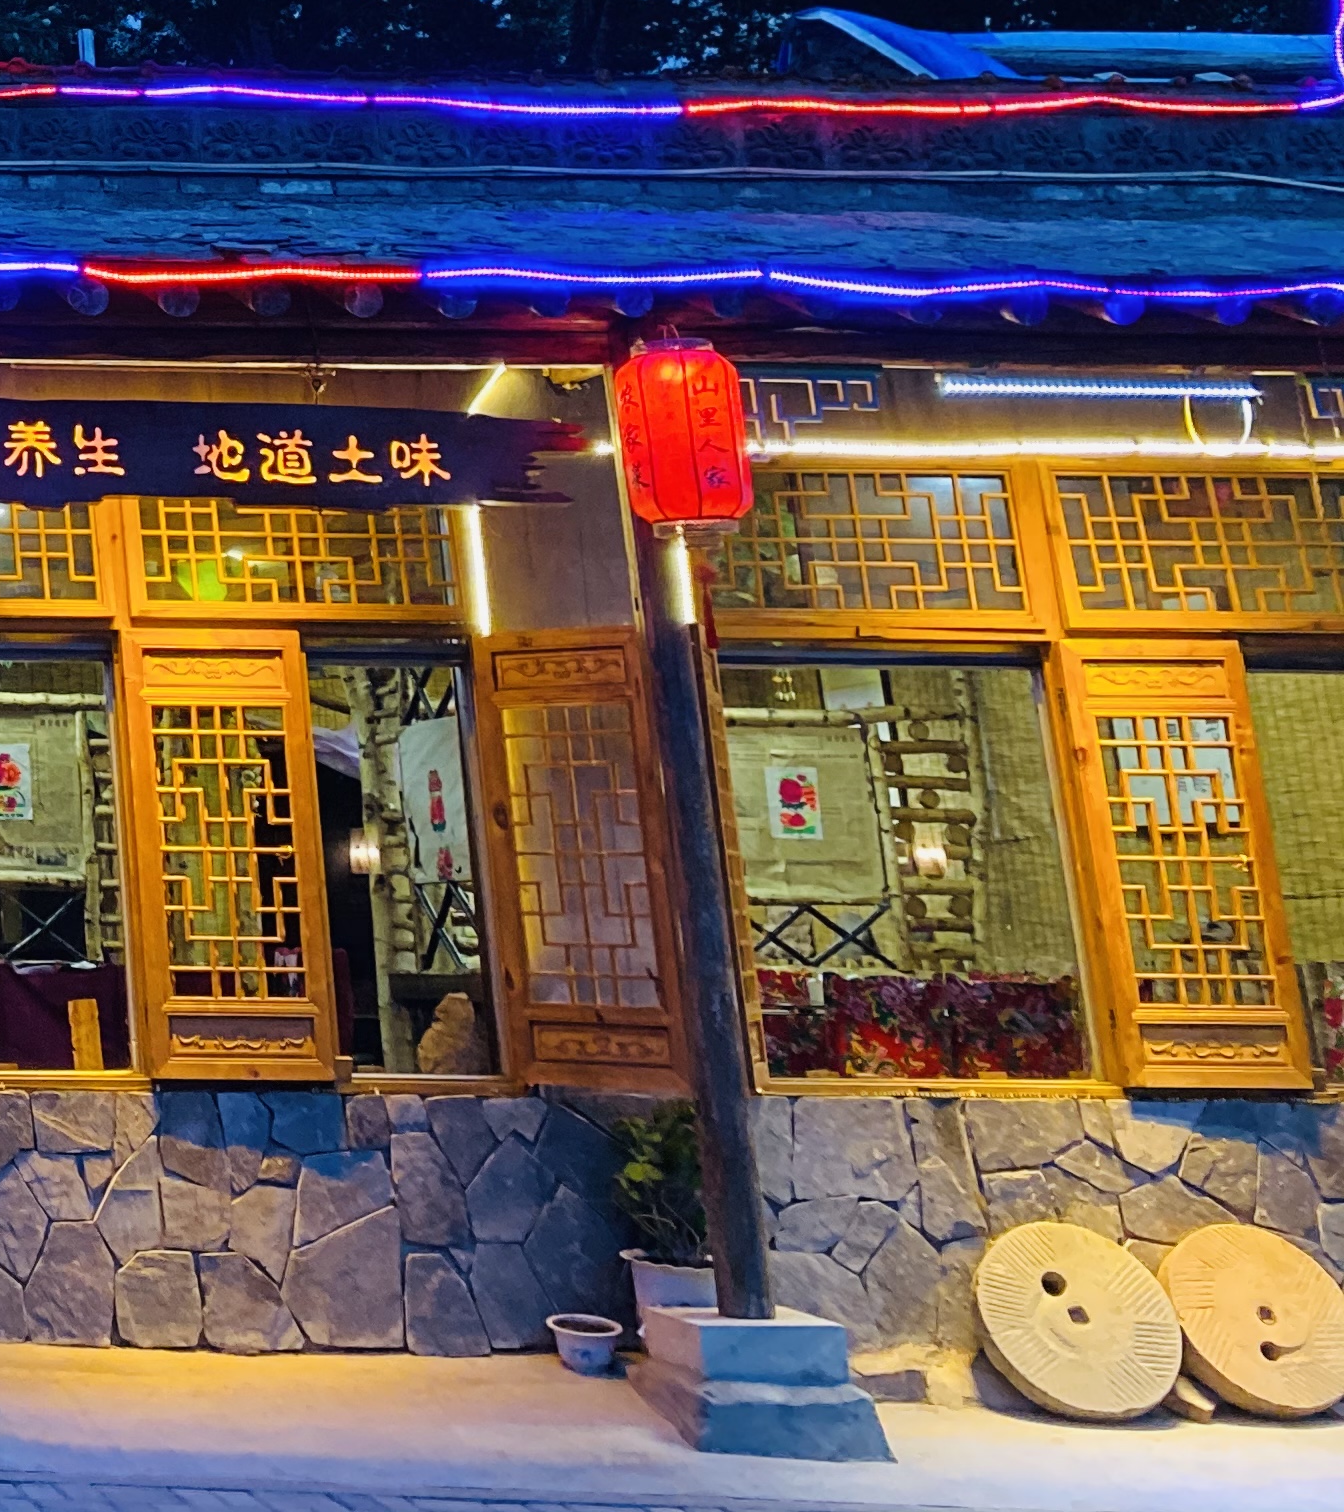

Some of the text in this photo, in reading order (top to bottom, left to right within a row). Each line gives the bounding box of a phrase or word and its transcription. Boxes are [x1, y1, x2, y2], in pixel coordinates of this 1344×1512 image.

[193, 428, 452, 488] 地道土味
[691, 375, 731, 489] 山里人家
